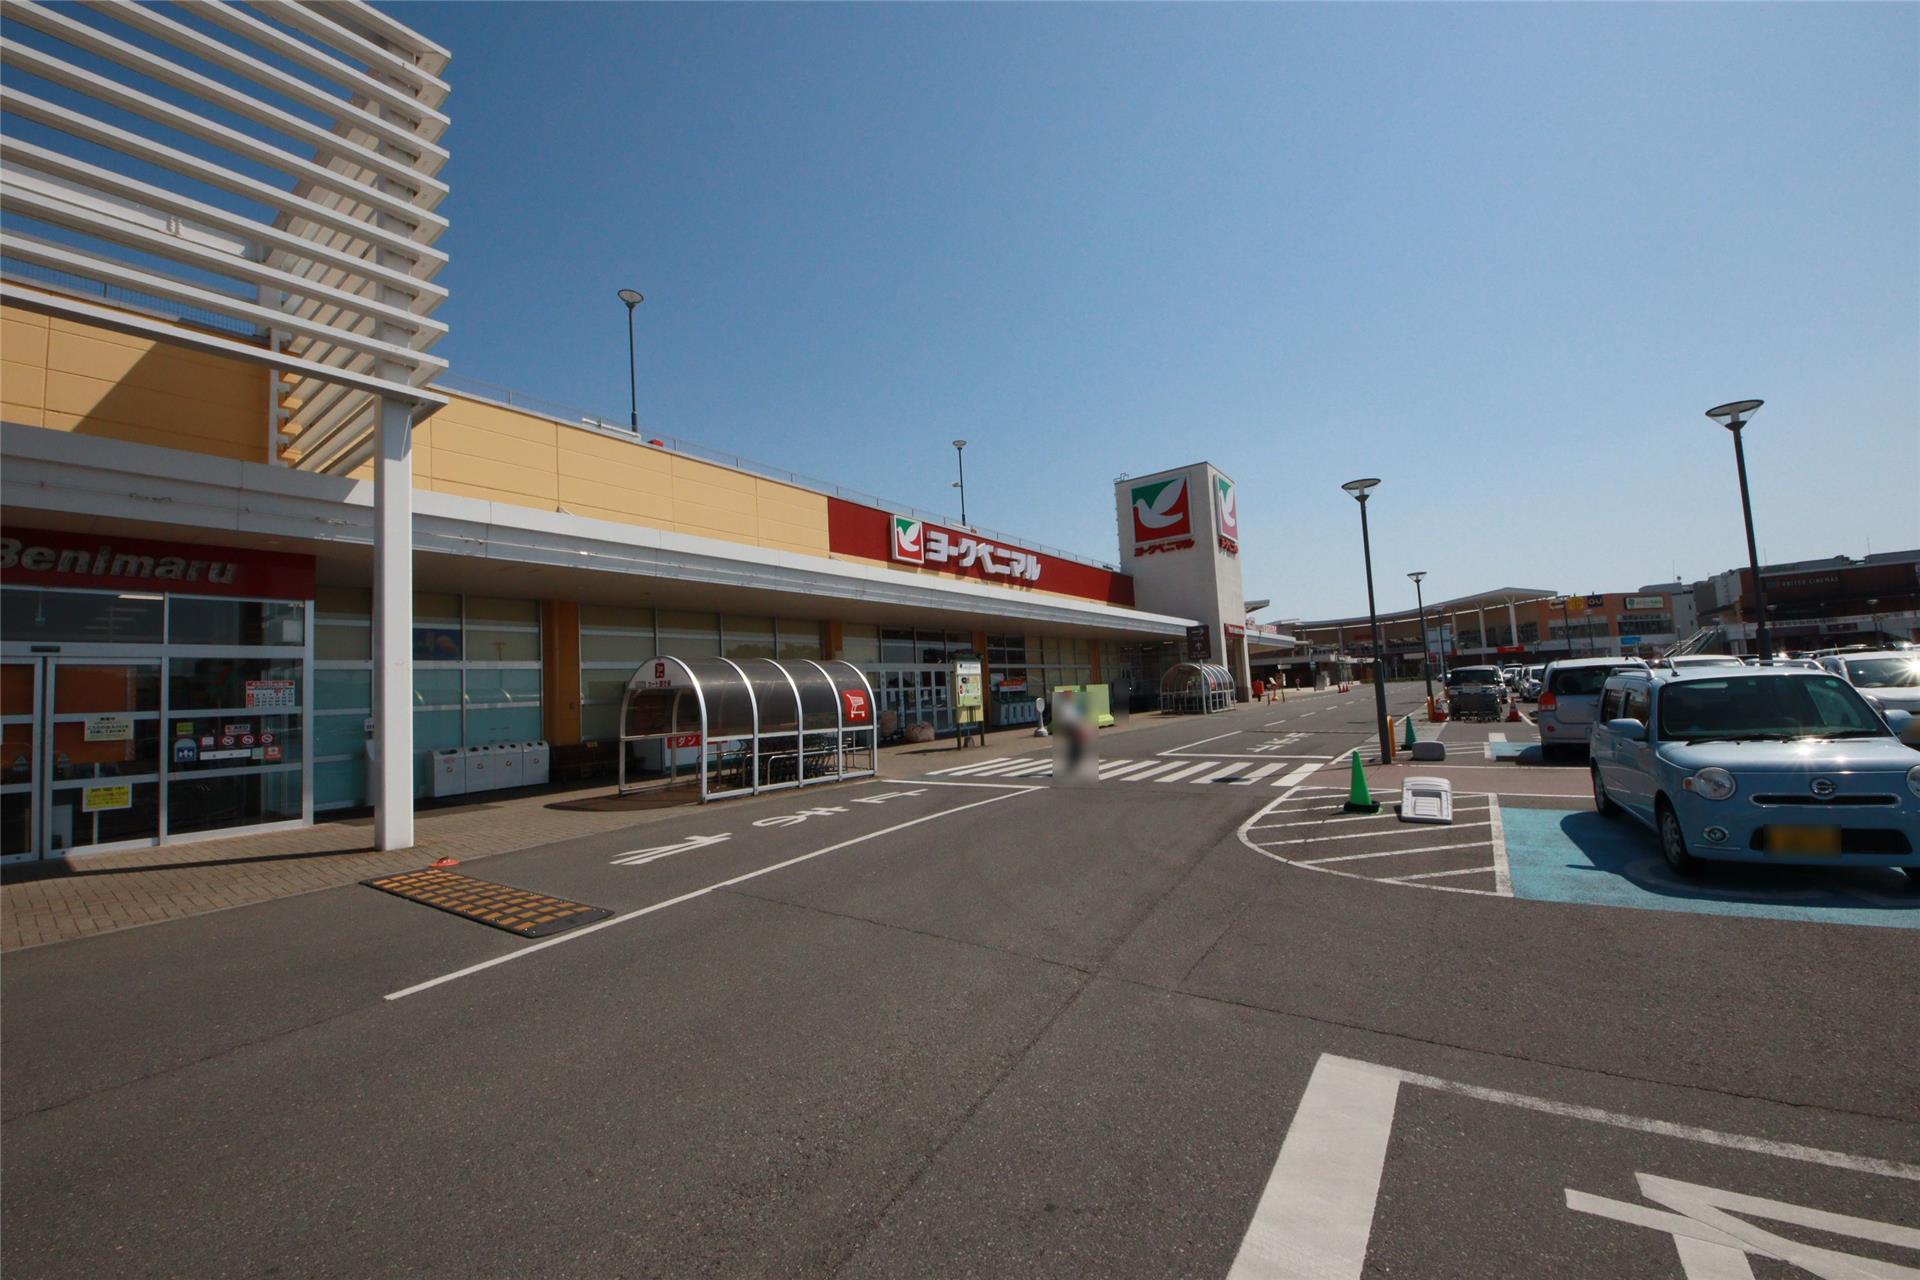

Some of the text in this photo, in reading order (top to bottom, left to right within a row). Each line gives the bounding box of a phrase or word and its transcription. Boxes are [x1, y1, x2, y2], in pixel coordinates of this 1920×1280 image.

[925, 530, 1042, 582] ヨークベニマル
